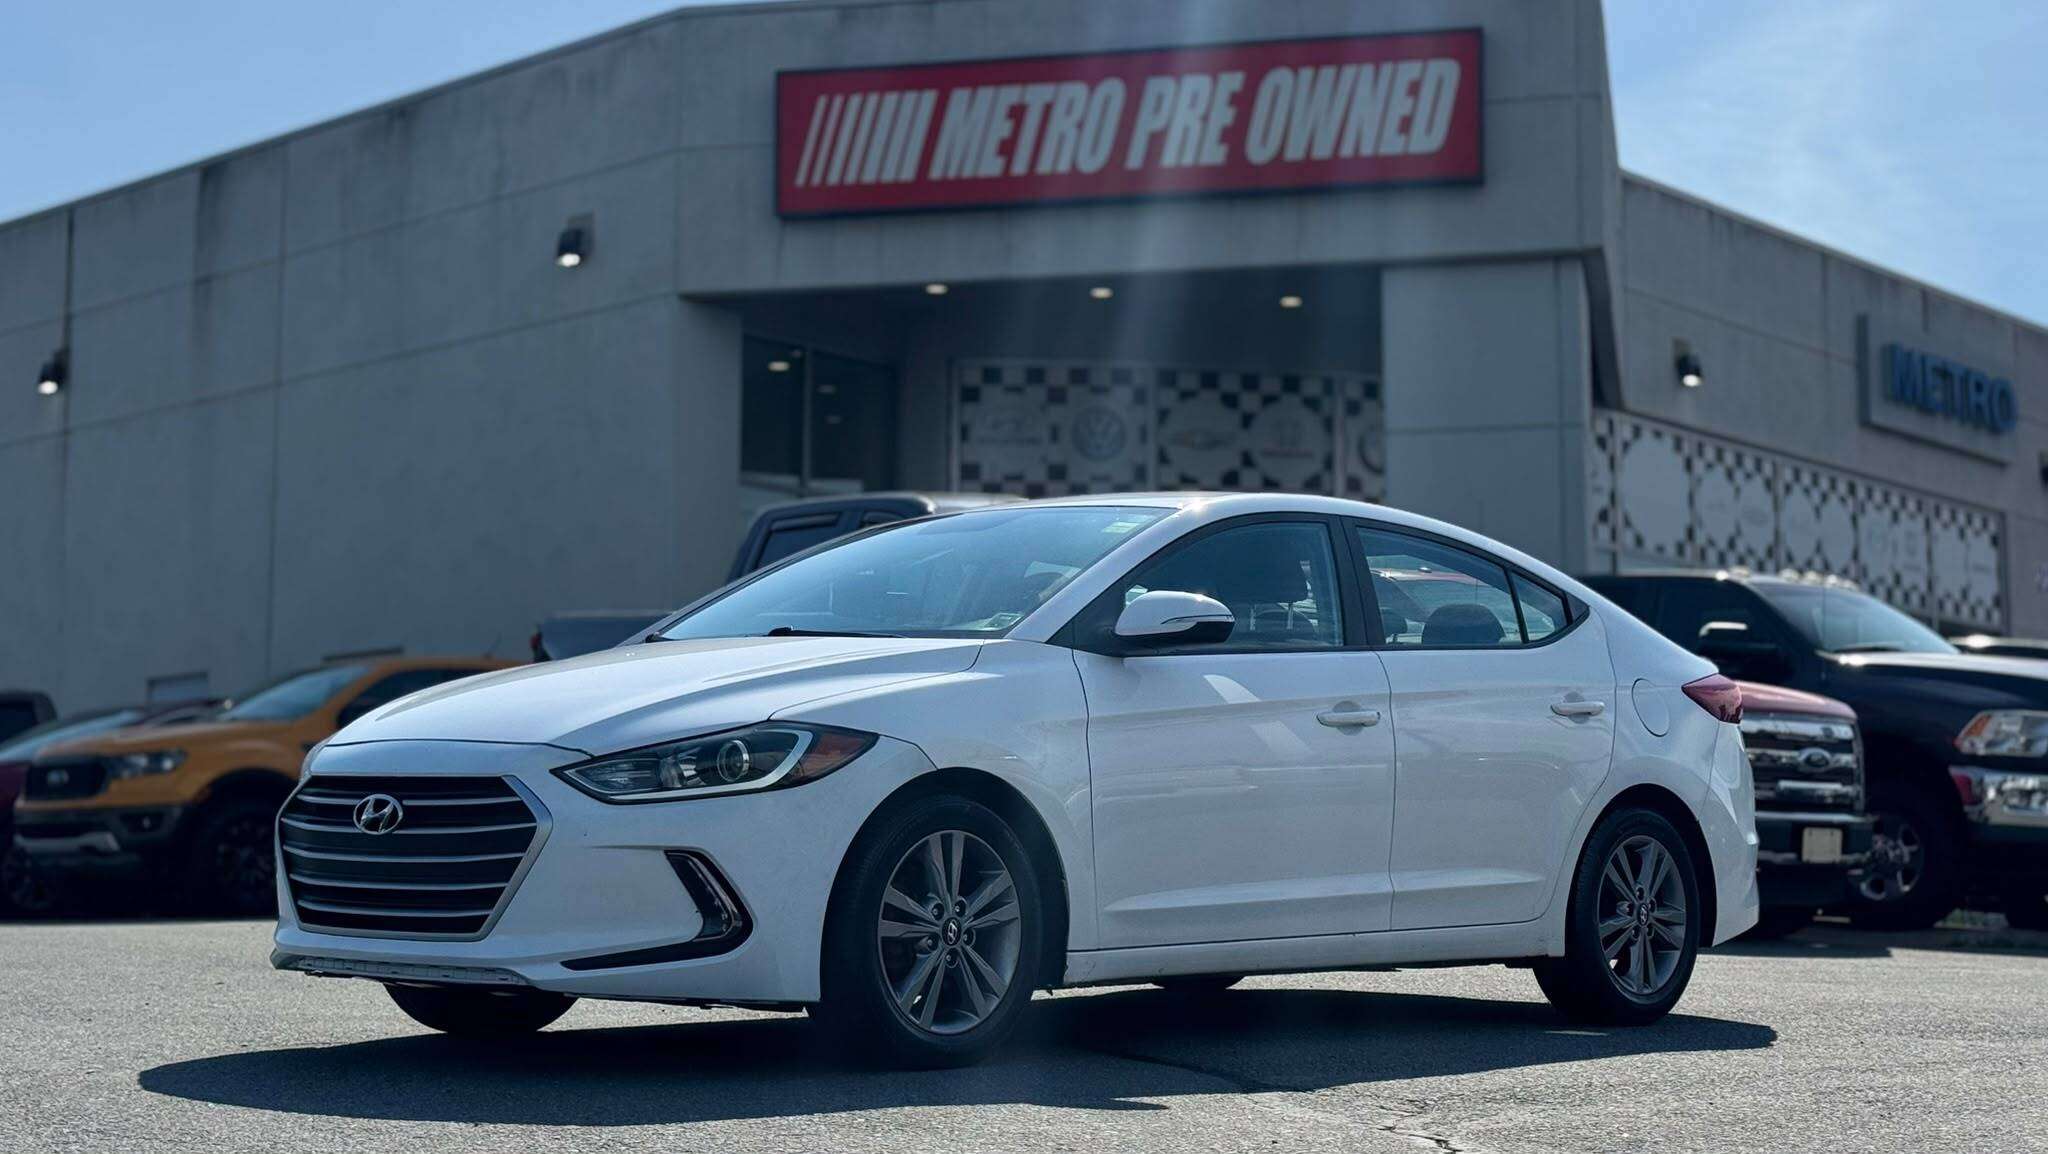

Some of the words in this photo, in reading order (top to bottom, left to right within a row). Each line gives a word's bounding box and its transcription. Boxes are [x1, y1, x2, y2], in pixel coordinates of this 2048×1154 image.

[928, 77, 1126, 181] METRO
[1125, 71, 1246, 170] PRE
[1245, 58, 1461, 165] OWNED
[1884, 343, 2018, 436] METRO
